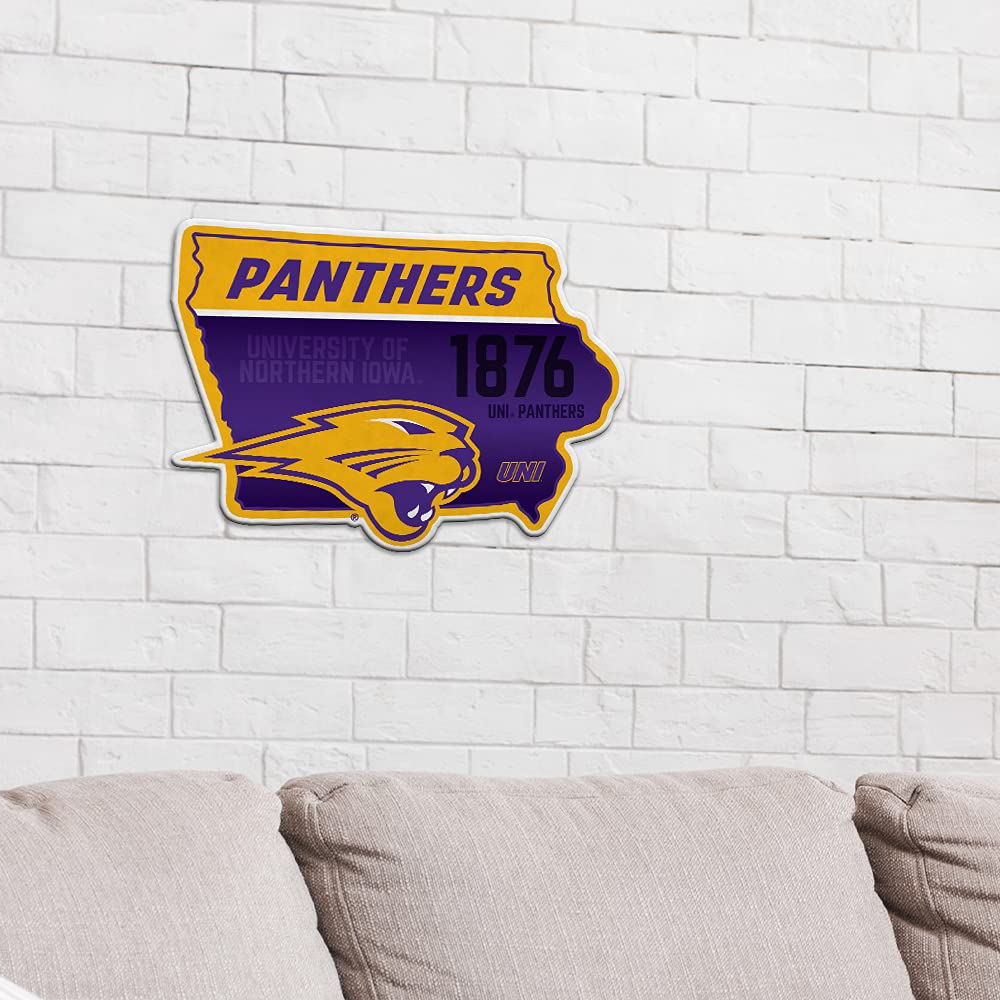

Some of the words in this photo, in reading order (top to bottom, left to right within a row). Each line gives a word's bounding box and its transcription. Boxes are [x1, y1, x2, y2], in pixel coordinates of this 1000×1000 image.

[226, 256, 522, 307] PANTHERS
[247, 334, 374, 360] UNIVERSITY
[382, 336, 409, 361] OF
[239, 359, 355, 384] NORTHERN
[450, 333, 575, 398] 1876
[518, 403, 585, 419] PANTHERS
[496, 461, 547, 483] UNI
